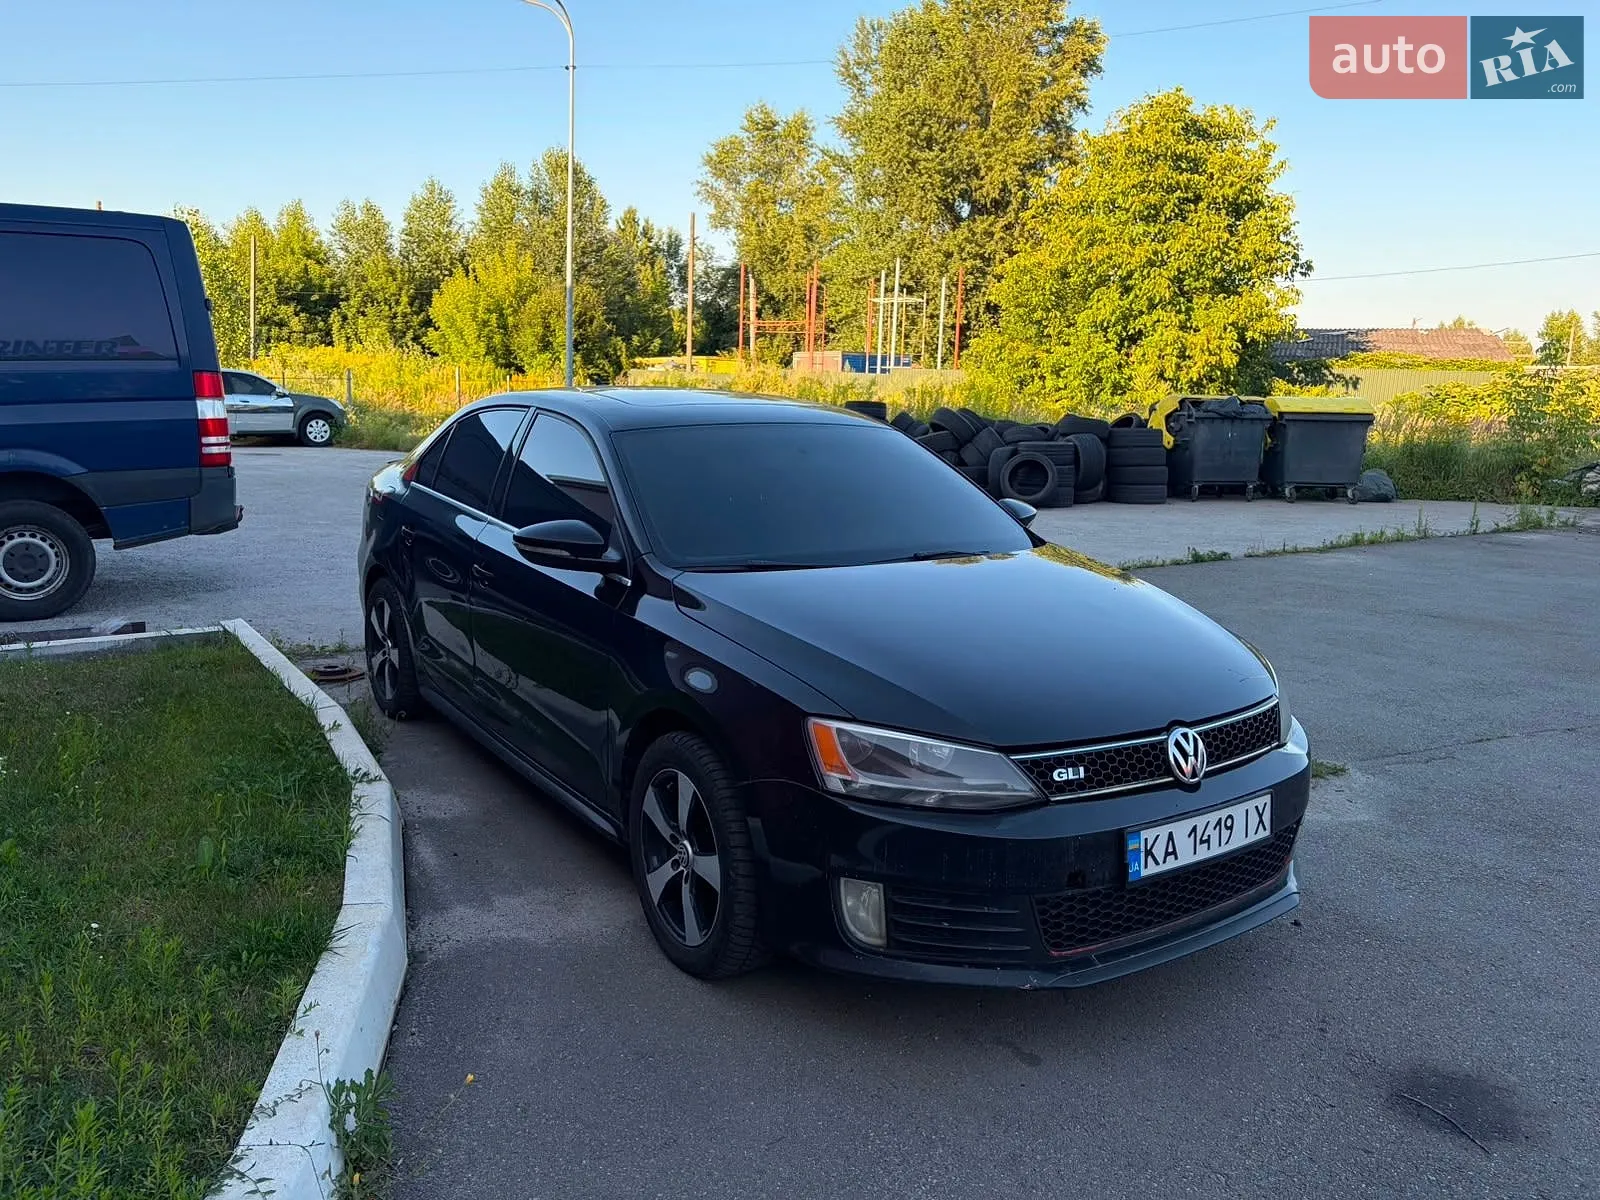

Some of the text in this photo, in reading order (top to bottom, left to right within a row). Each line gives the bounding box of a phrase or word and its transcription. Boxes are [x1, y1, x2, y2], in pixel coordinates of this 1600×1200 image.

[1052, 766, 1085, 781] GLI
[1144, 802, 1268, 869] KA 1419 IX
[1128, 861, 1140, 873] UA
